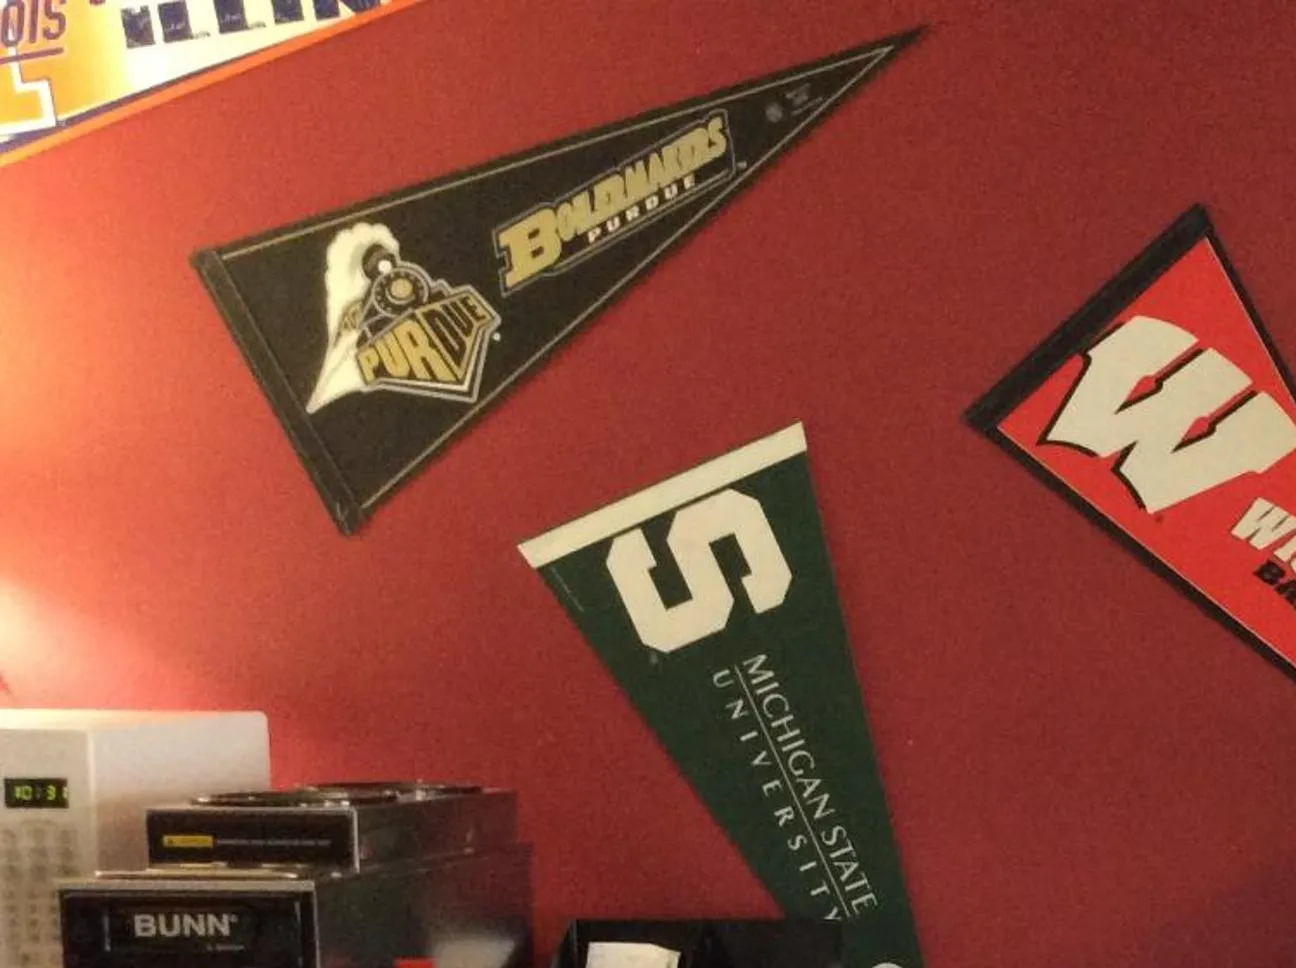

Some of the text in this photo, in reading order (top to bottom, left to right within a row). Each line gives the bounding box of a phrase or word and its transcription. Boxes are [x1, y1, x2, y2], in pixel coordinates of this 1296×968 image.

[587, 174, 697, 244] PURDUE
[357, 296, 488, 385] PURDUE
[606, 487, 792, 654] S
[712, 669, 843, 922] UNIVERSITY
[742, 653, 879, 916] MICHIGAN STATE
[134, 913, 230, 938] BUNN
